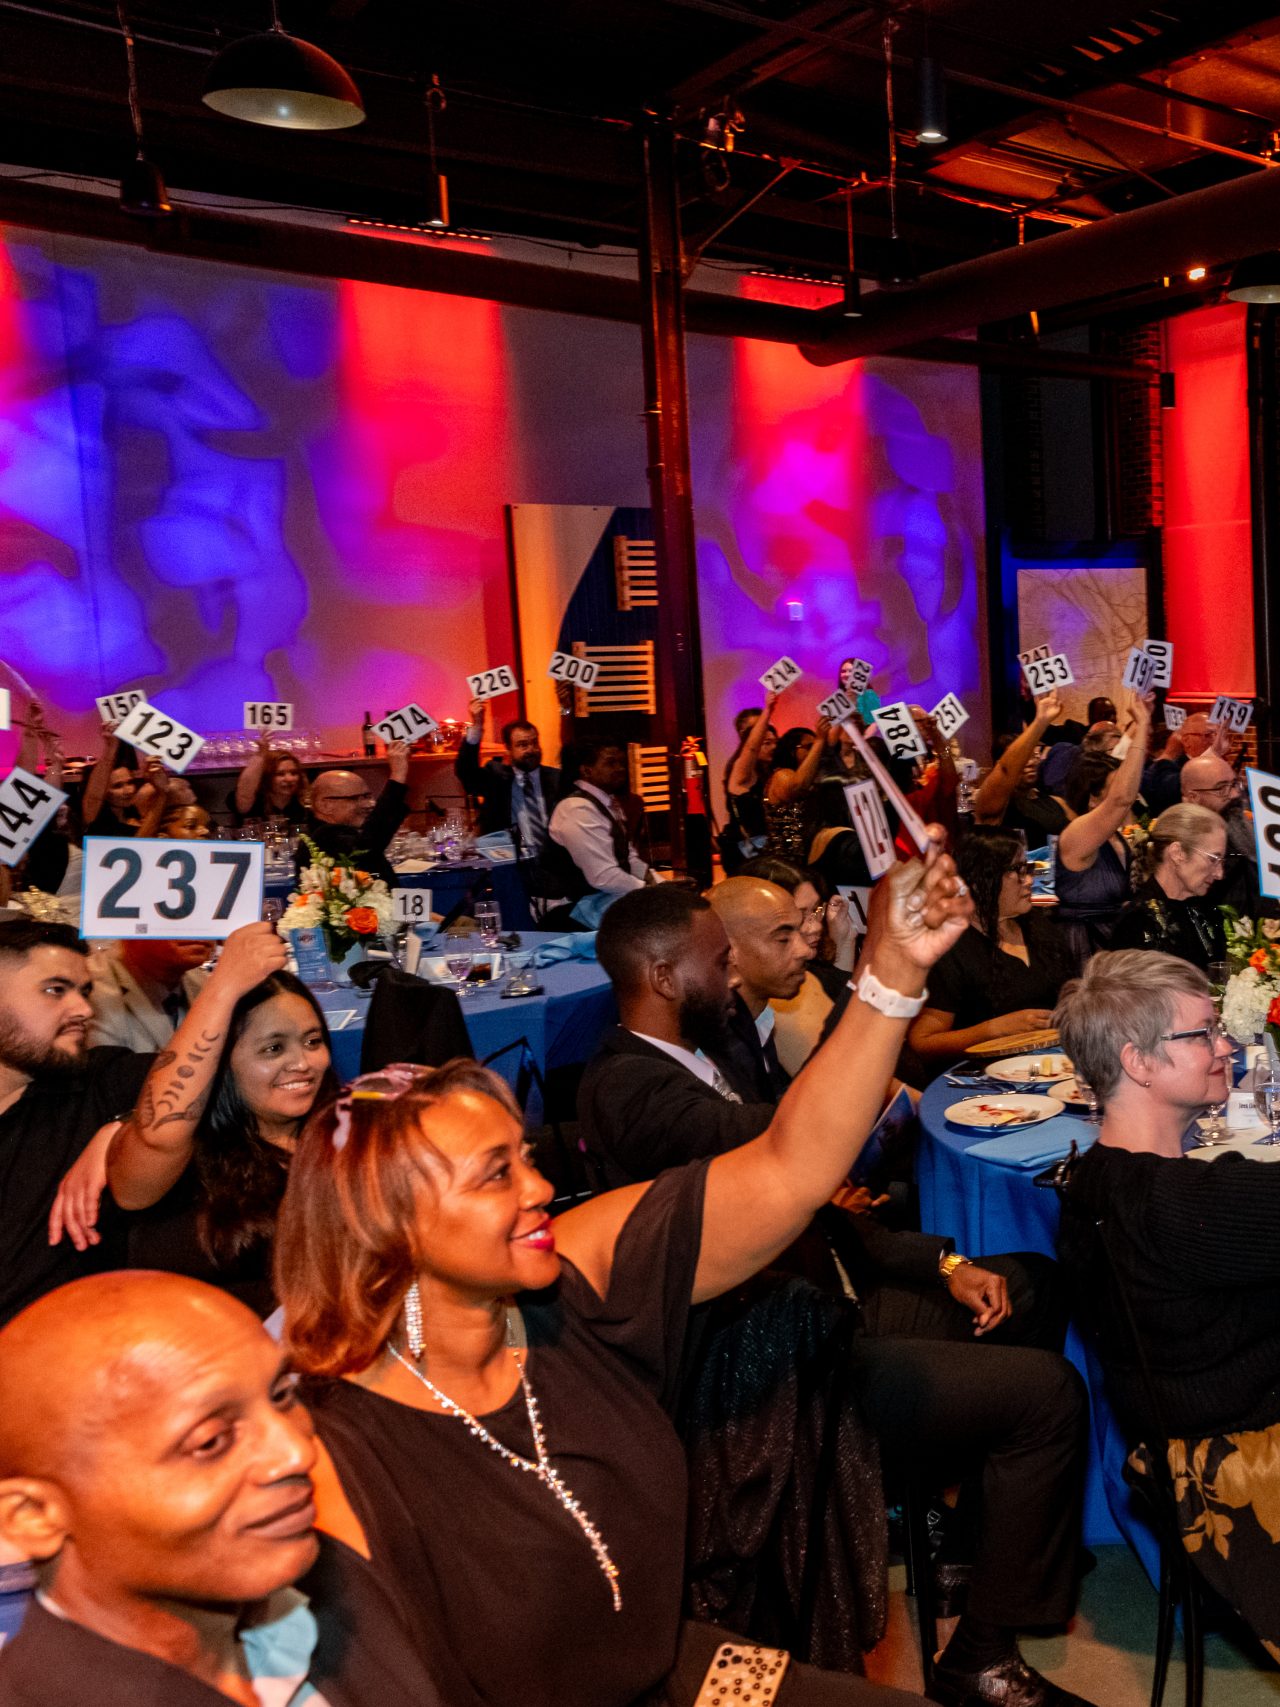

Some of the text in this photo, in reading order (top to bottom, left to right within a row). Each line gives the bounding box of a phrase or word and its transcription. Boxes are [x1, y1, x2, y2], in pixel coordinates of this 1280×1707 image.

[471, 669, 511, 696] 226
[551, 655, 594, 685] 200
[764, 659, 797, 691] 214
[850, 661, 871, 692] 283
[1029, 657, 1068, 688] 253
[248, 705, 287, 726] 165
[821, 693, 850, 721] 270
[935, 697, 962, 731] 251
[1216, 700, 1249, 725] 159
[131, 712, 193, 760] 123
[379, 707, 431, 743] 274
[878, 707, 918, 757] 284
[0, 778, 51, 849] 144
[97, 848, 252, 921] 237
[400, 894, 424, 916] 18
